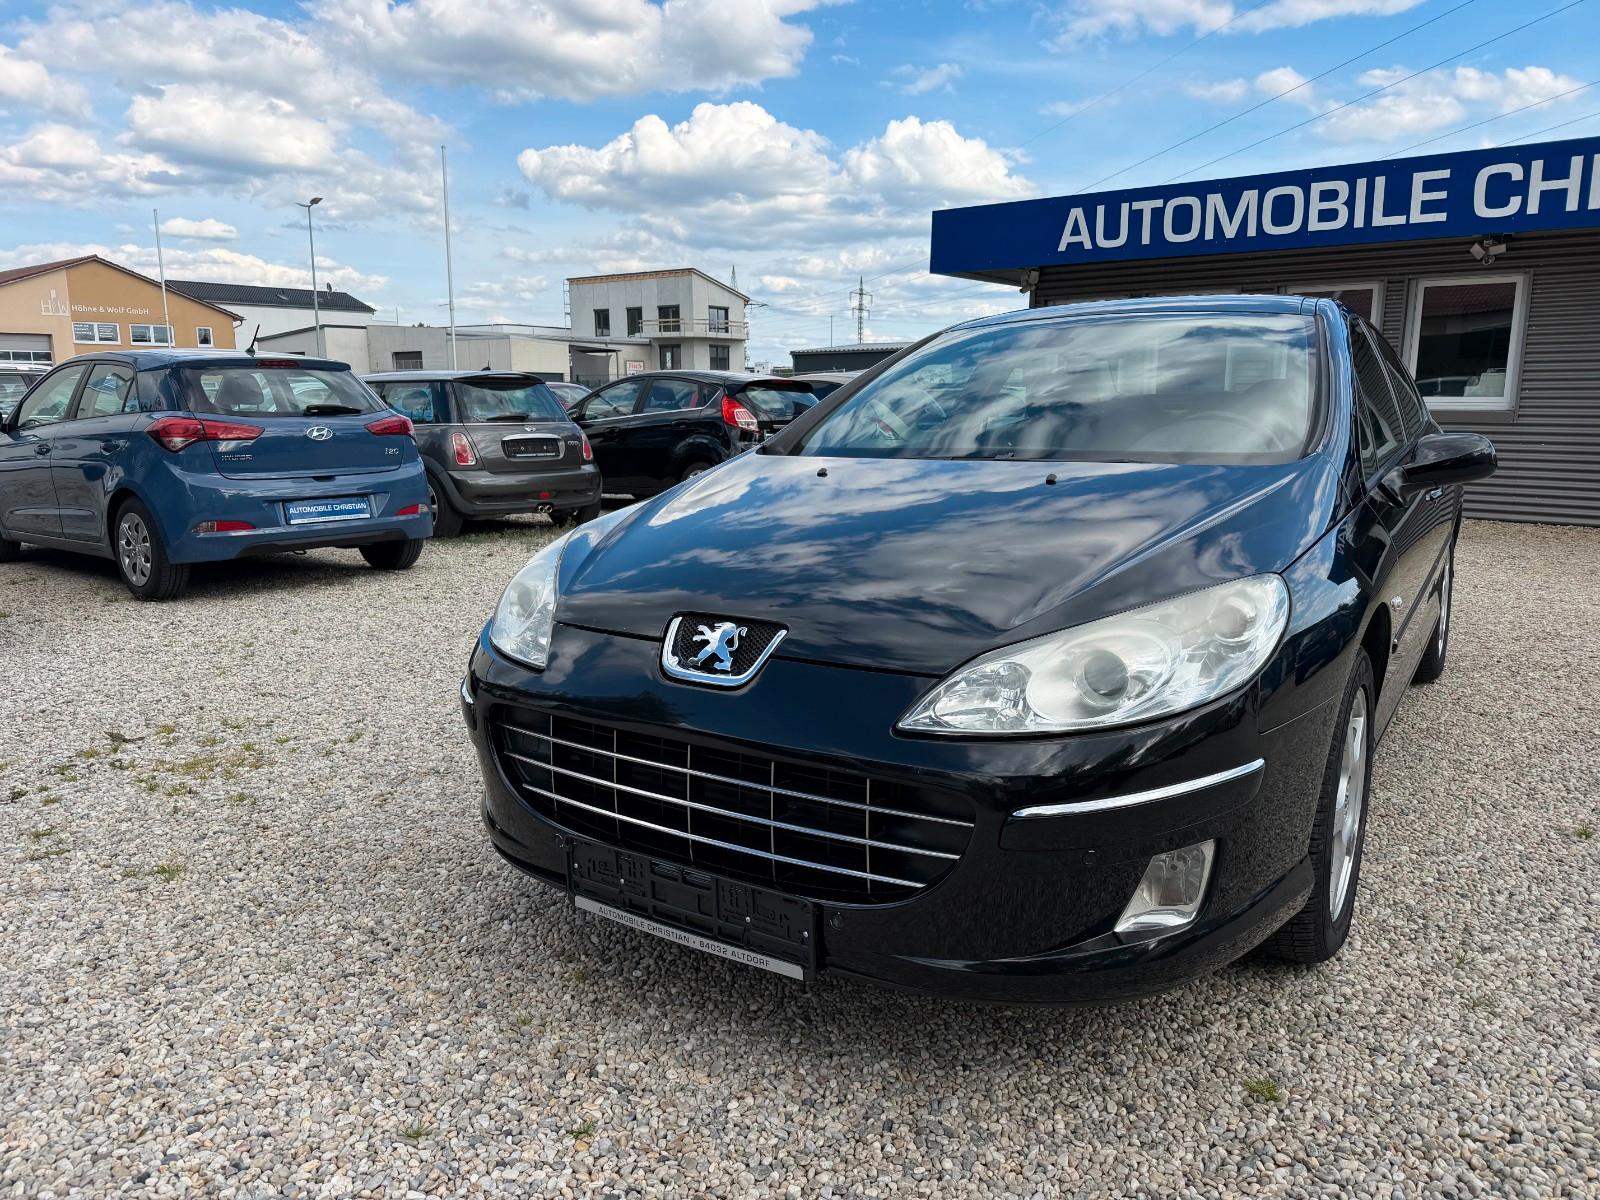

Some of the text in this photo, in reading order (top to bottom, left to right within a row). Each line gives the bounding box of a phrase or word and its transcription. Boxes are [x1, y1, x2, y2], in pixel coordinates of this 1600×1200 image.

[1057, 168, 1451, 251] AUTOMOBILE
[71, 304, 149, 315] Höhne & Wolf GmbH
[289, 502, 367, 514] AUTOMOBILE CHRISTIAN
[598, 906, 771, 967] AUTOMOBILE CHRISTIAN 84032 ALTDORF
